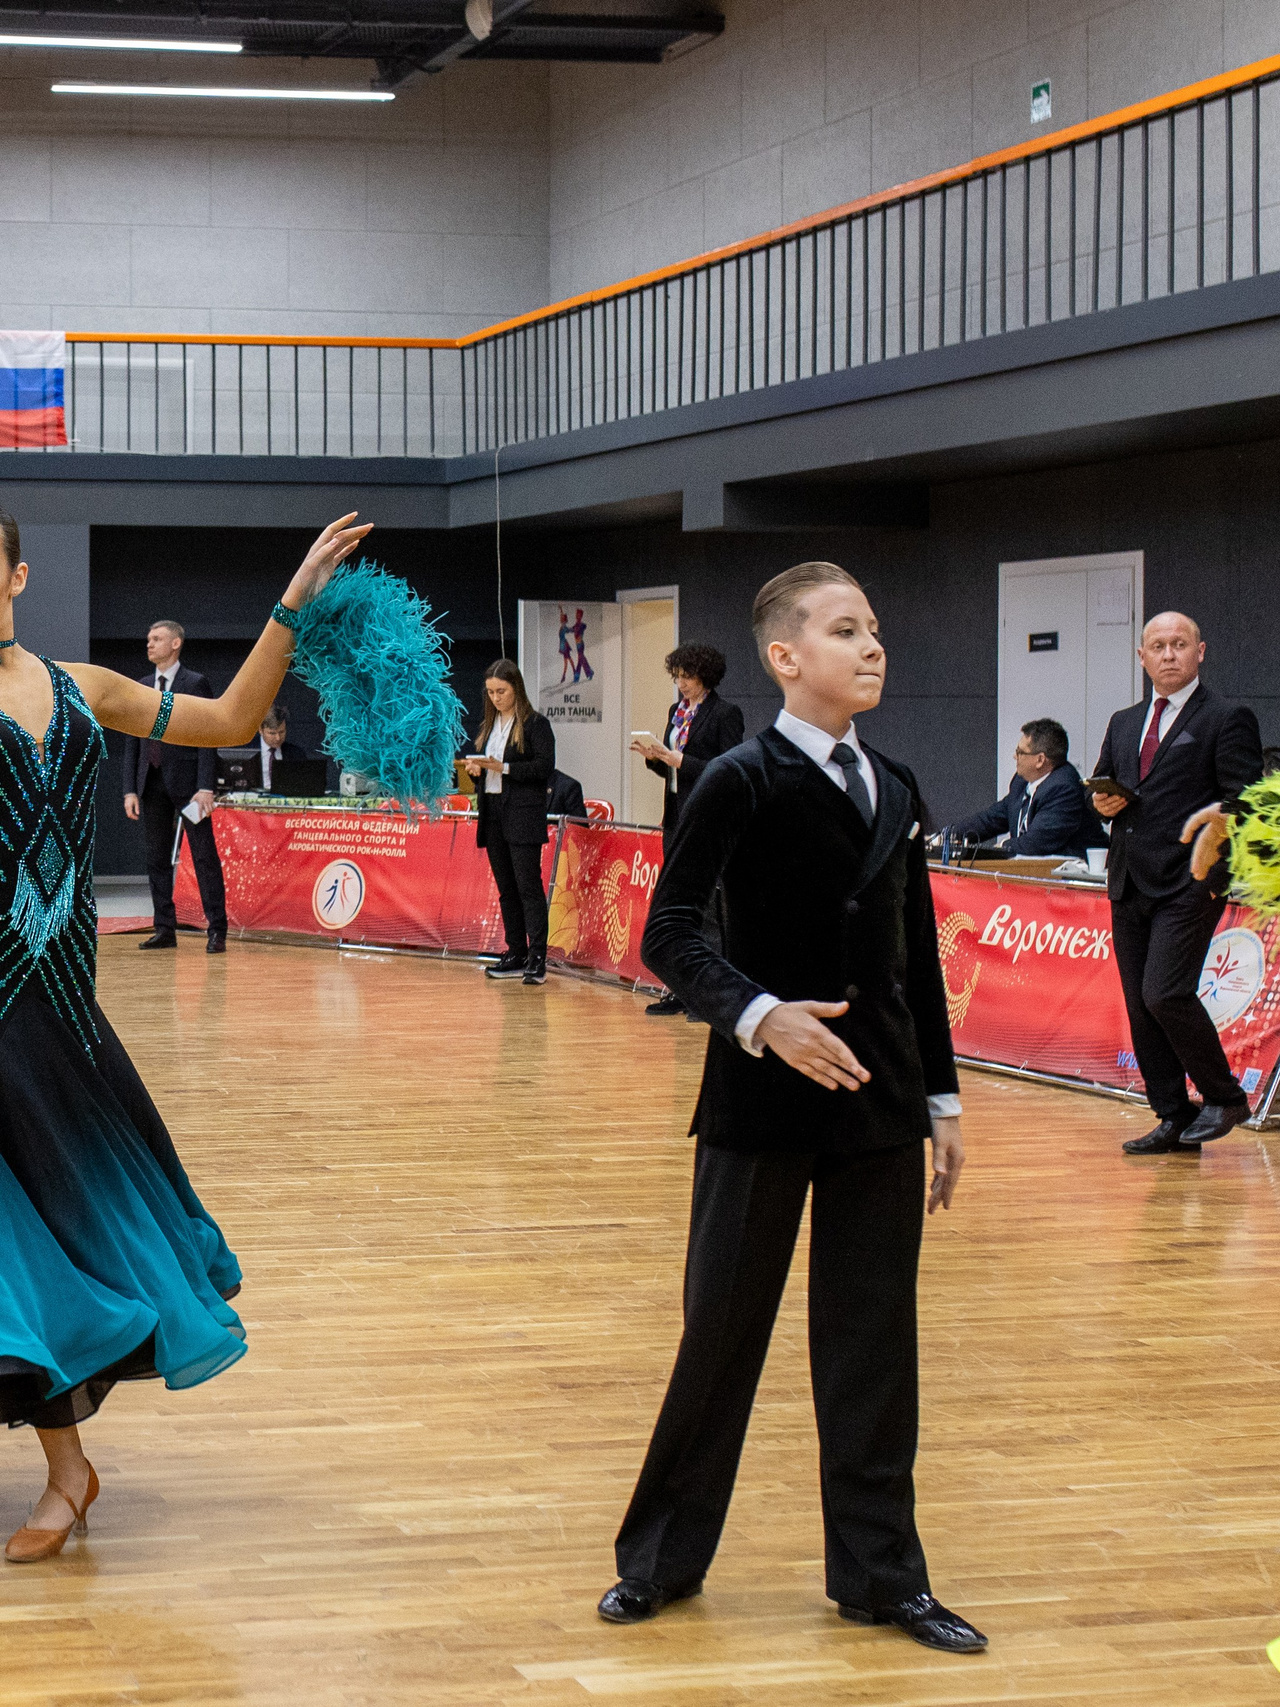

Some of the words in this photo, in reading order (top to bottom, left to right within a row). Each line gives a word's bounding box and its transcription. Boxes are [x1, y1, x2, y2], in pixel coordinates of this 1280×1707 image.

[563, 694, 580, 703] ВСЕ
[546, 706, 565, 717] ДЛЯ
[568, 706, 596, 717] ТАНЦА
[285, 818, 360, 831] ВСЕРОССИЙСКАЯ
[362, 821, 420, 834] ФЕДЕРАЦИЯ
[293, 831, 361, 843] ТАНЦЕВАЛЬНОГО
[363, 835, 397, 845] СПОРТА
[399, 837, 406, 846] И
[288, 842, 356, 854] АКРОБАТИЧЕСКОГО
